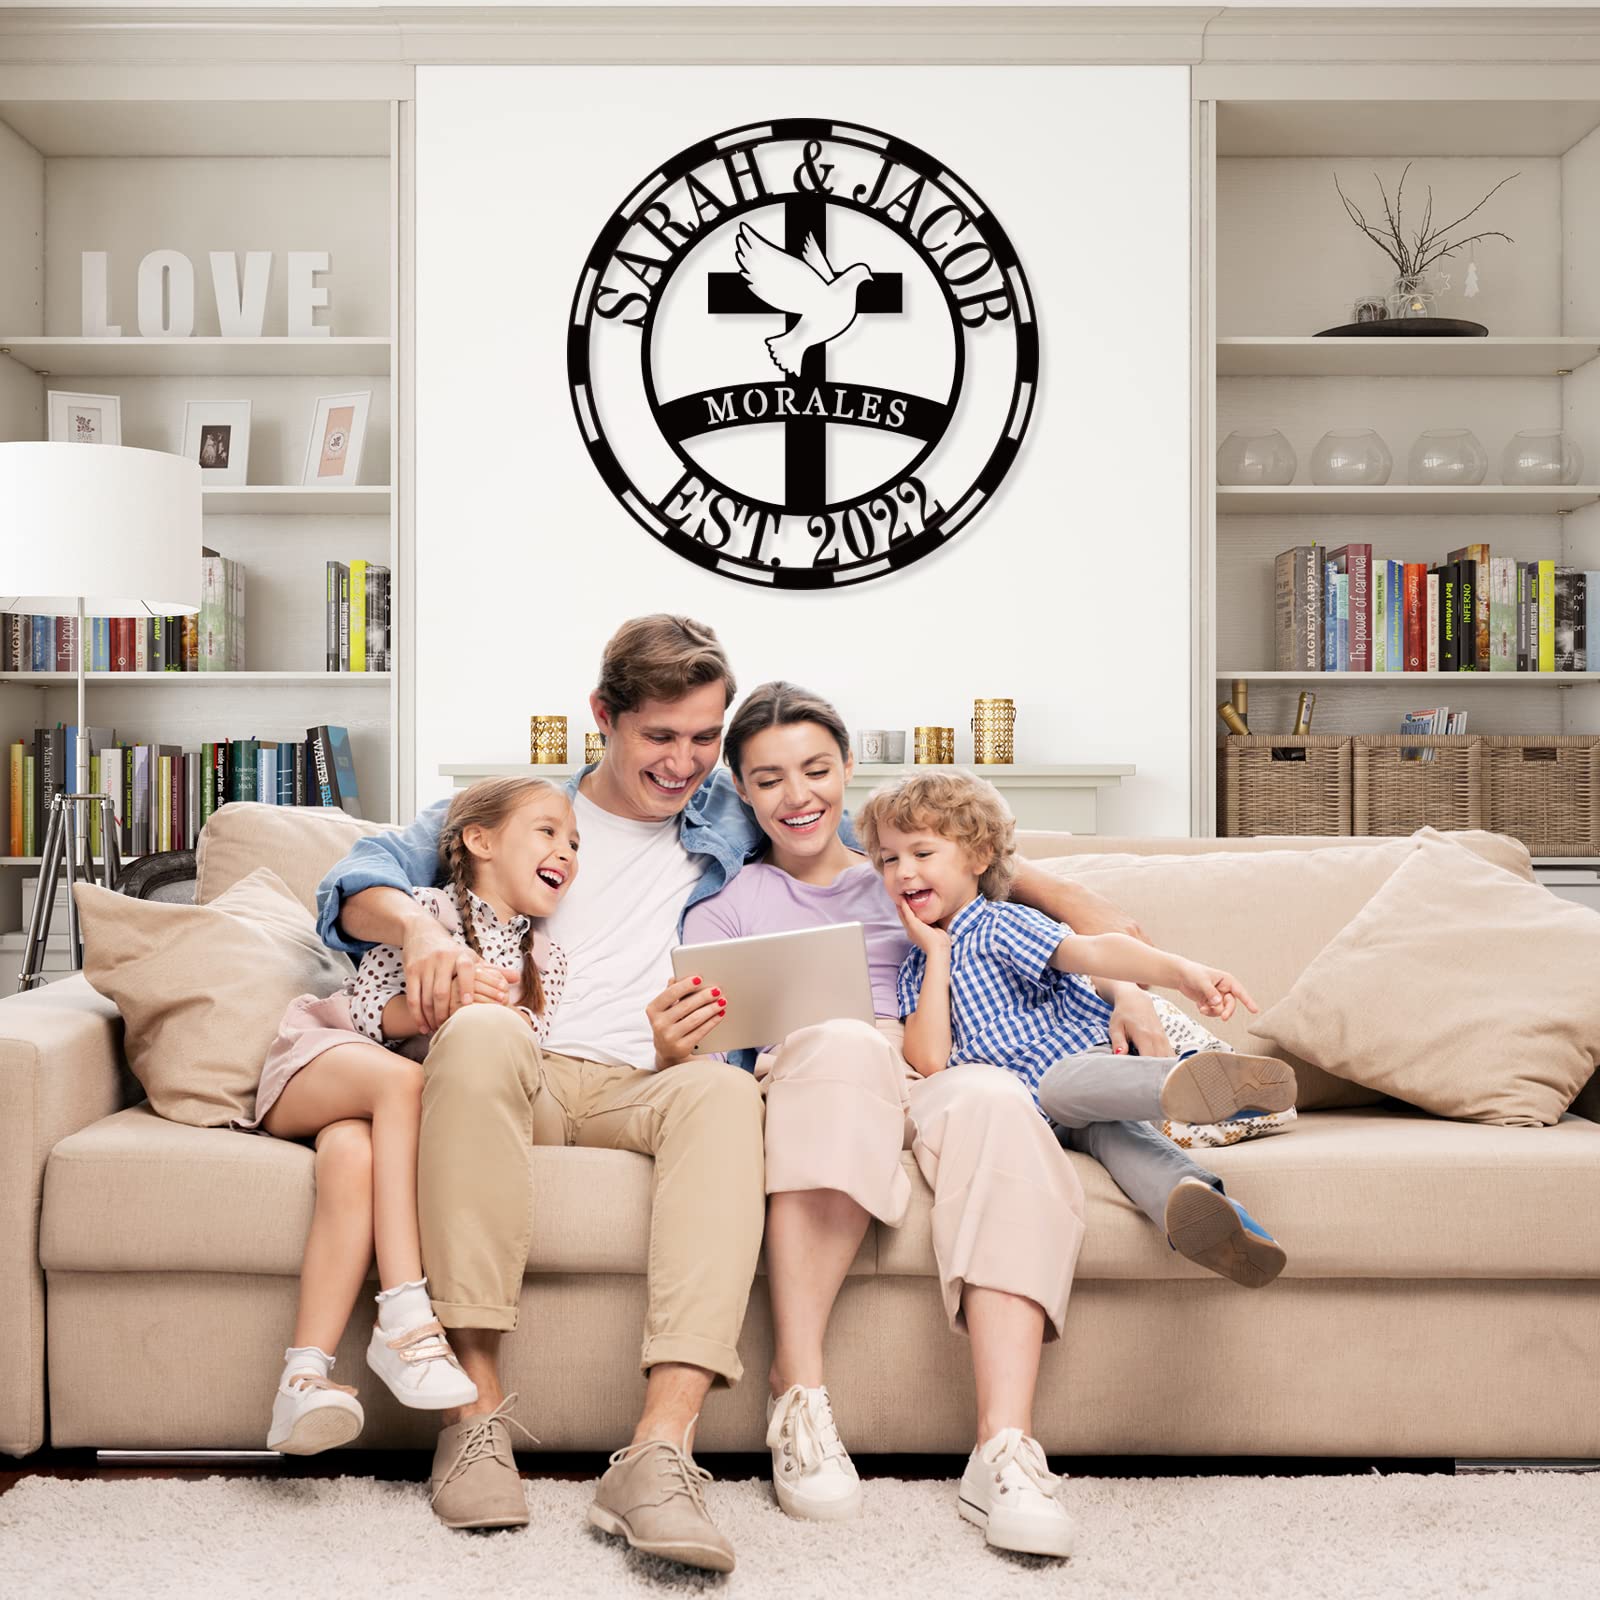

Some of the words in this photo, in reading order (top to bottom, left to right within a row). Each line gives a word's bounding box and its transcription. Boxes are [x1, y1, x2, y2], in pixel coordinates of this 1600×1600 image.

[594, 143, 773, 329] SARAH
[793, 139, 834, 196] &
[853, 152, 1013, 330] JACOB
[82, 249, 331, 337] LOVE
[703, 386, 909, 429] MORALES
[651, 461, 782, 567] EST.
[806, 475, 946, 567] 2022
[1306, 551, 1316, 601] APPEAL
[1350, 555, 1367, 594] carnival
[1350, 595, 1366, 608] of
[1446, 583, 1454, 599] Best
[1463, 584, 1471, 623] INFERNO
[1411, 599, 1419, 616] Story
[1306, 601, 1316, 668] MAGNETIC
[1354, 609, 1372, 641] power
[57, 643, 73, 661] The
[1350, 643, 1366, 662] The
[44, 746, 53, 765] Man
[215, 764, 224, 777] your
[313, 738, 329, 785] WALTER
[44, 768, 53, 783] and
[44, 785, 53, 809] Piano
